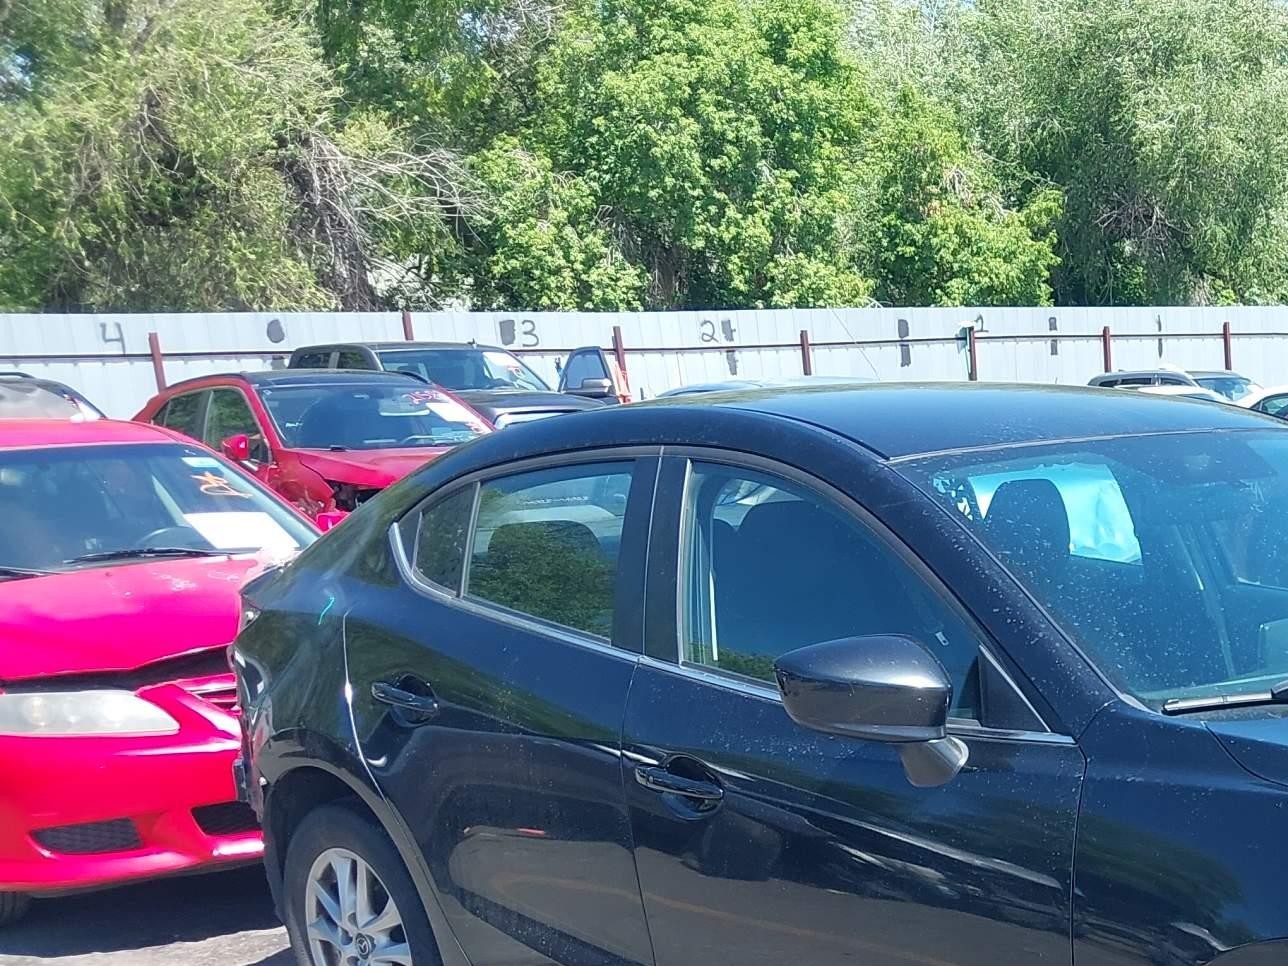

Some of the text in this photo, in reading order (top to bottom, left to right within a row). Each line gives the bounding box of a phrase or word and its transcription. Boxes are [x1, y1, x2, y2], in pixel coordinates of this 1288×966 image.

[99, 321, 126, 354] 4
[521, 319, 540, 348] 3
[700, 319, 719, 344] 2
